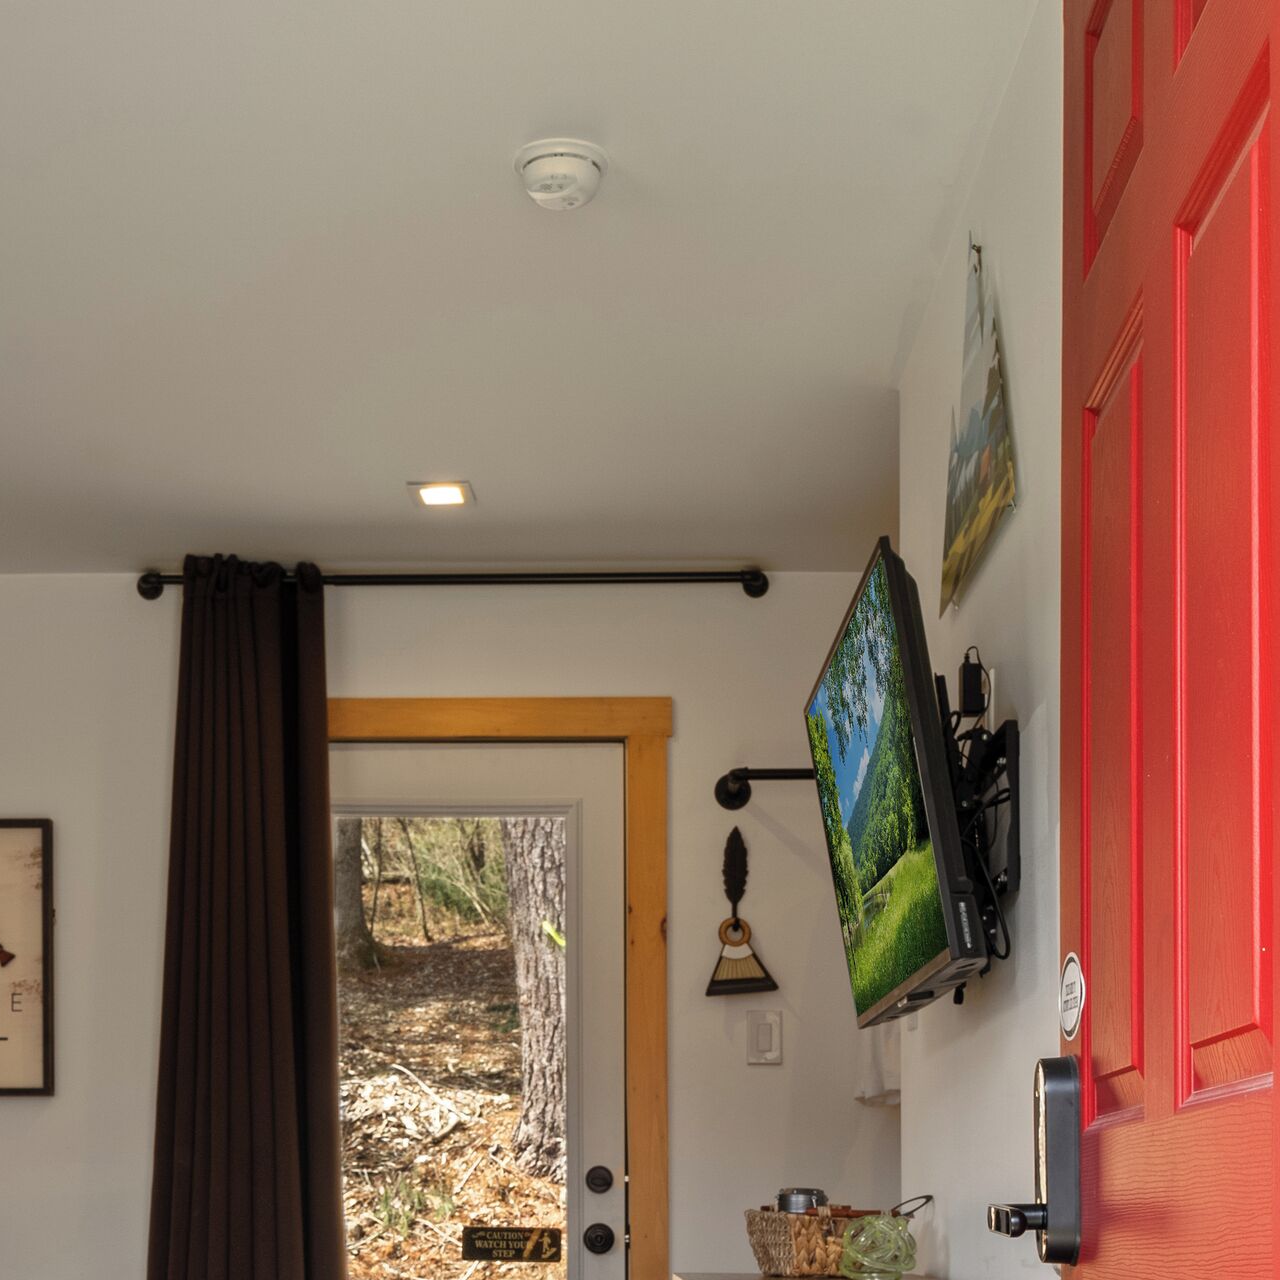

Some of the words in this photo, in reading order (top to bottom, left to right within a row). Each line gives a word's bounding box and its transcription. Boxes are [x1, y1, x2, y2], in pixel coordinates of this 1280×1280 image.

[486, 1231, 523, 1239] CAUTION
[475, 1240, 506, 1248] WATCH
[492, 1249, 515, 1258] STEP
